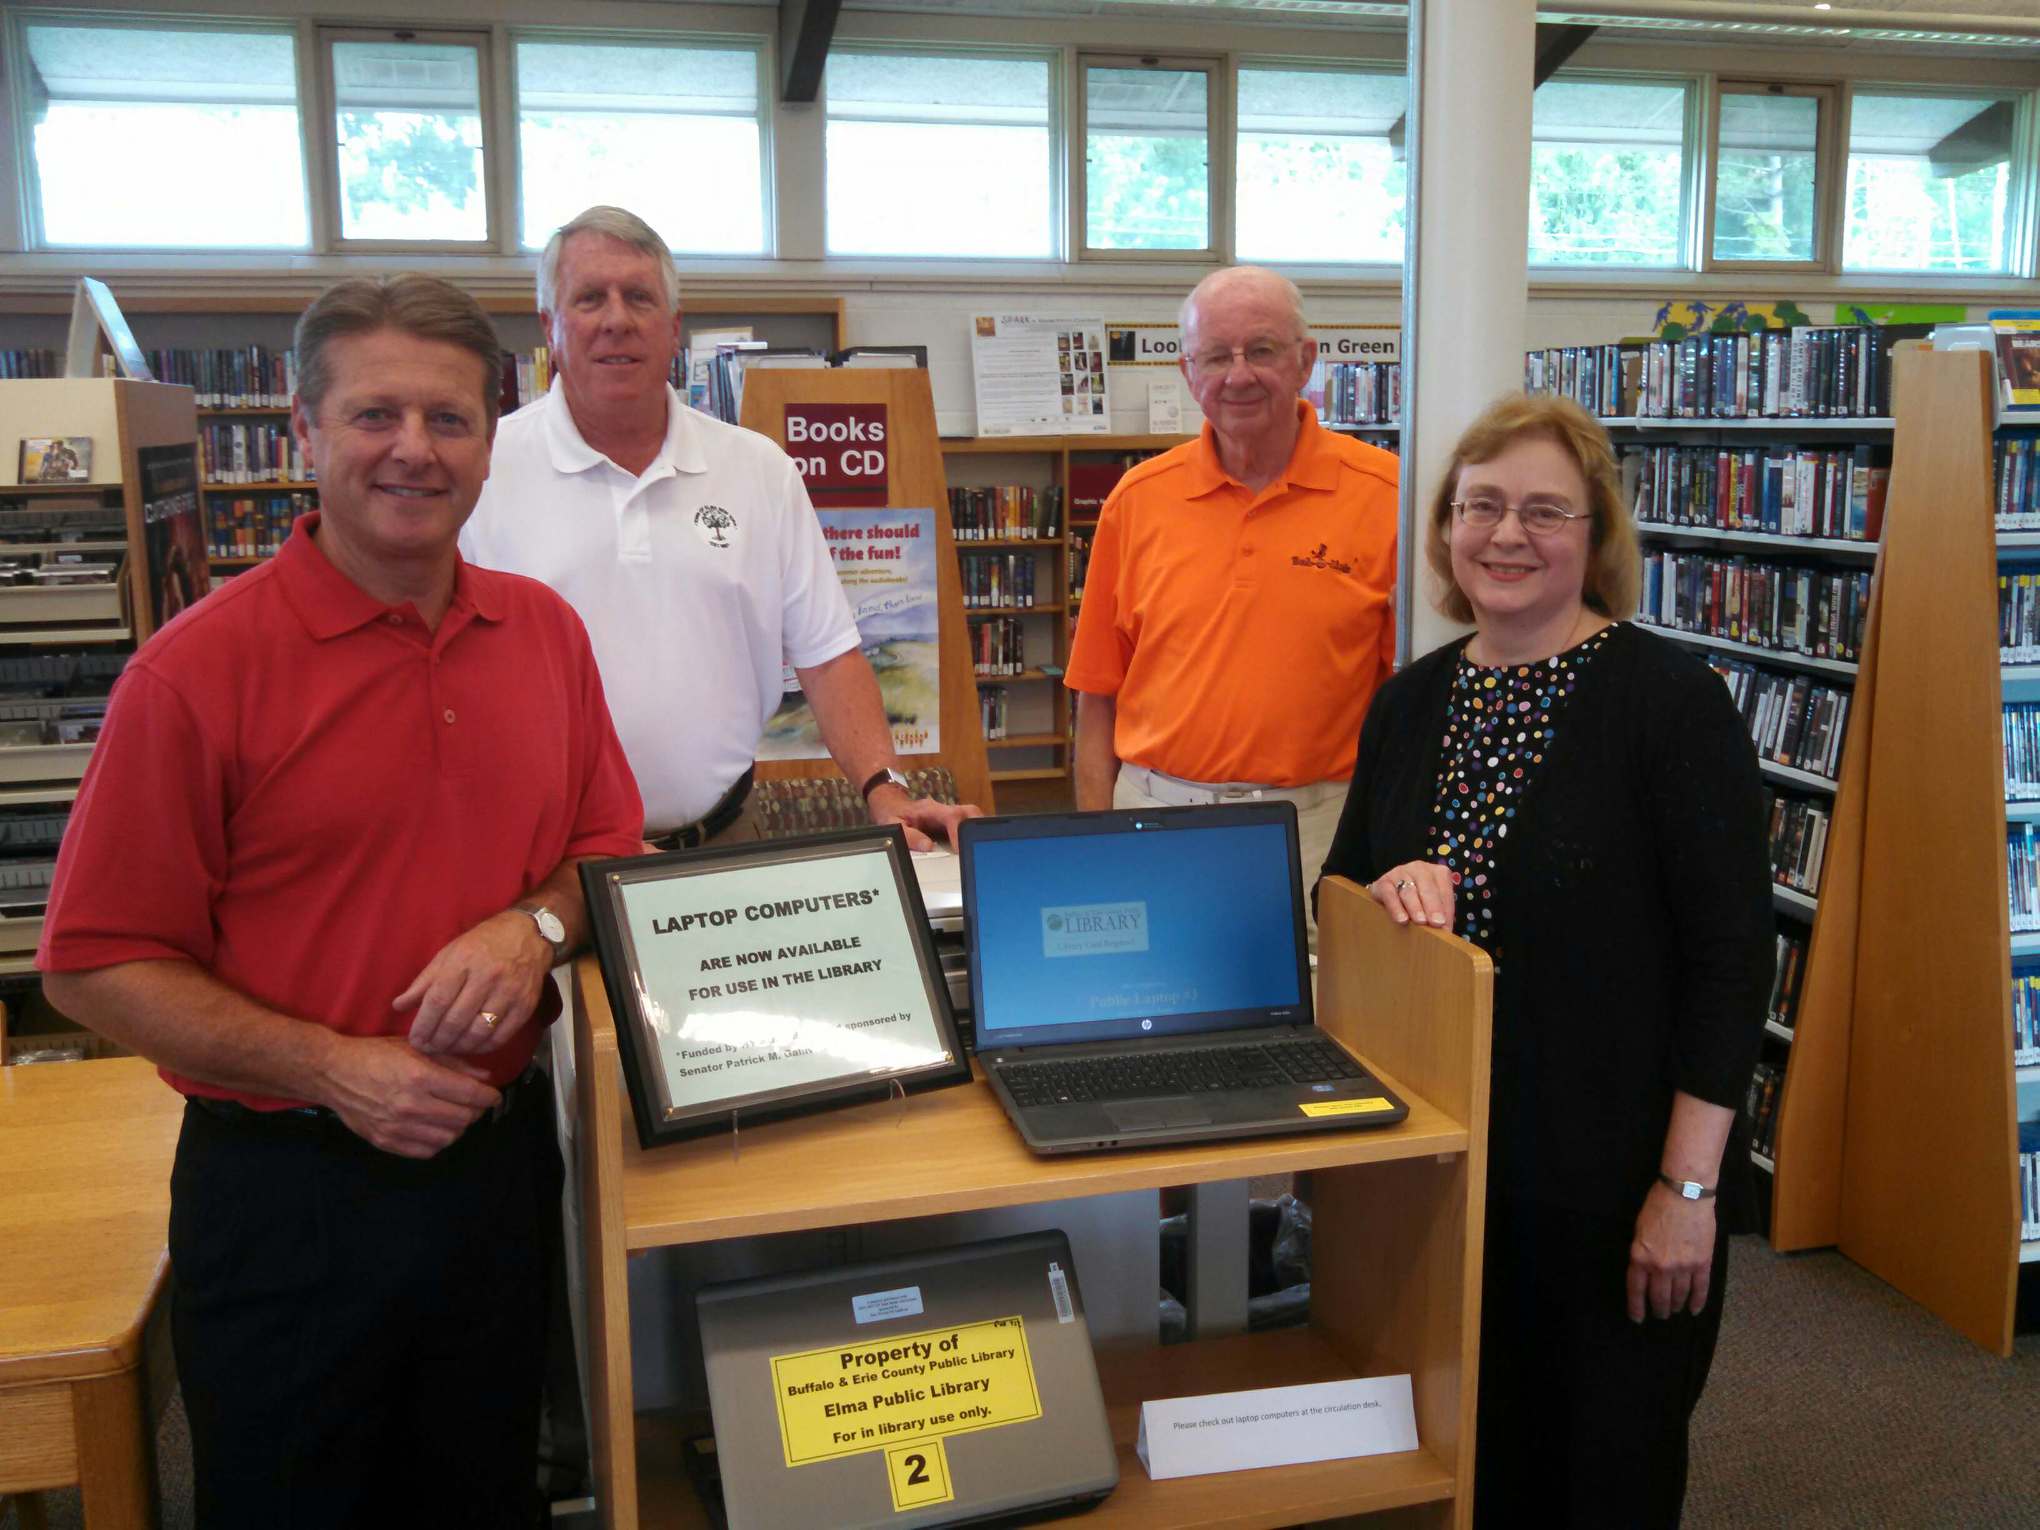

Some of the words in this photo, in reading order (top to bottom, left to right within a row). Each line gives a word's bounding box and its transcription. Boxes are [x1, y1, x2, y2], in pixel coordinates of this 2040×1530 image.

[1142, 338, 1182, 354] Loo
[1319, 342, 1331, 354] n
[1337, 339, 1394, 354] Green
[787, 416, 885, 442] Books
[792, 456, 827, 476] on
[840, 449, 885, 476] CD
[822, 525, 863, 540] there
[867, 523, 920, 539] should
[839, 547, 864, 561] the
[867, 545, 901, 560] fun!
[652, 908, 738, 935] LAPTOP
[1064, 914, 1141, 933] LIBRARY
[700, 956, 732, 972] ARE
[736, 950, 773, 966] NOW
[777, 936, 862, 960] AVAILABLE
[688, 985, 722, 1001] FOR
[726, 979, 759, 995] USE
[762, 975, 779, 990] IN
[782, 970, 815, 986] THE
[818, 959, 883, 981] LIBRARY
[845, 1013, 897, 1030] sponsored
[899, 1012, 912, 1021] by
[679, 1062, 723, 1077] Senator
[726, 1055, 766, 1069] Patrick
[768, 1052, 781, 1061] M.
[840, 1341, 933, 1370] Property
[938, 1334, 959, 1351] of
[787, 1379, 834, 1396] Buffalo
[838, 1376, 848, 1387] &
[852, 1372, 878, 1386] Erie
[881, 1363, 926, 1381] County
[928, 1356, 968, 1371] Public
[971, 1347, 1016, 1364] Library
[824, 1401, 868, 1418] Elma
[872, 1391, 926, 1409] Public
[930, 1376, 990, 1400] Library
[832, 1430, 857, 1444] For
[861, 1427, 875, 1439] in
[878, 1418, 926, 1436] library
[929, 1412, 955, 1426] use
[959, 1404, 992, 1422] only.
[1173, 1420, 1198, 1431] Please
[1199, 1417, 1220, 1428] check
[1221, 1416, 1234, 1426] out
[1235, 1413, 1260, 1425] laptop
[1260, 1409, 1300, 1422] computers
[1301, 1408, 1309, 1416] at
[1310, 1406, 1323, 1415] the
[1324, 1402, 1362, 1414] circulation
[1362, 1399, 1382, 1410] desk.
[903, 1453, 930, 1486] 2
